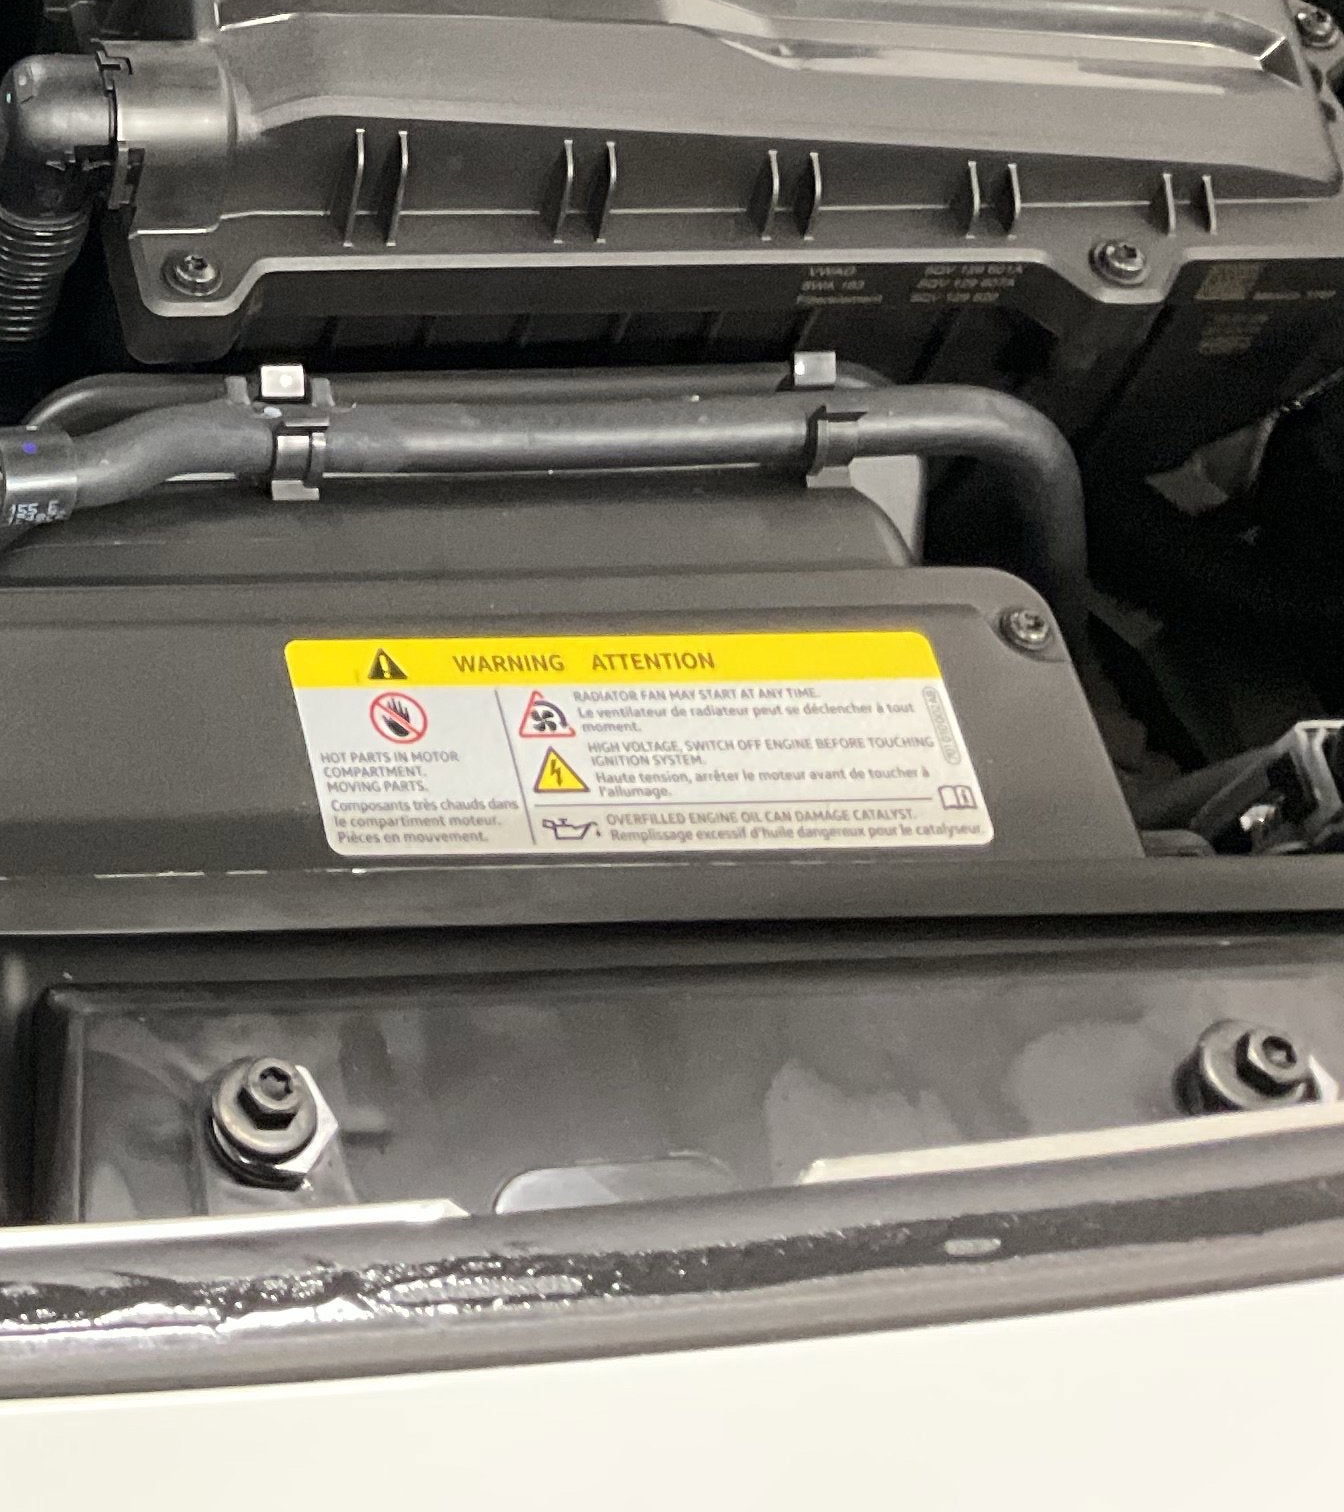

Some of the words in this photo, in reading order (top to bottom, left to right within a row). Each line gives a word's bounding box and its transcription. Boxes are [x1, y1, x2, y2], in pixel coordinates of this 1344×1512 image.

[452, 655, 565, 672] WARNING
[592, 652, 715, 671] ATTENTION
[573, 690, 638, 702] RADIATOR
[641, 690, 666, 700] FAN
[669, 690, 695, 701] MAY
[699, 689, 736, 700] START
[741, 688, 754, 699] AT
[759, 689, 782, 698] ANY
[577, 707, 594, 719] Le
[597, 706, 666, 718] ventilateur
[671, 706, 687, 717] de
[690, 705, 748, 716] radiateur
[752, 705, 782, 717] peut
[785, 706, 800, 715] se
[803, 702, 872, 715] déclencher
[876, 702, 884, 713] à
[886, 703, 914, 713] tout
[582, 722, 641, 732] moment.
[588, 742, 620, 753] HIGH
[685, 740, 734, 751] SWITCH
[737, 740, 761, 751] OFF
[765, 739, 812, 750] ENGINE
[815, 738, 865, 749] BEFORE
[868, 737, 934, 748] TOUCHING
[320, 752, 346, 763] HOT
[350, 752, 391, 763] PARTS
[394, 752, 408, 762] IN
[411, 751, 459, 762] MOTOR
[591, 755, 649, 766] IGNITION
[595, 772, 636, 783] Haute
[695, 769, 738, 782] arrêter
[742, 769, 755, 781] le
[759, 771, 805, 781] moteur
[810, 769, 846, 780] avant
[849, 768, 865, 779] de
[868, 767, 917, 779] toucher
[922, 766, 930, 778] à
[327, 781, 381, 792] MOVING
[331, 800, 411, 816] Composants
[413, 799, 438, 811] très
[440, 799, 486, 811] chauds
[488, 799, 519, 811] dans
[334, 816, 347, 827] le
[350, 816, 446, 830] compartiment
[449, 816, 501, 826] moteur.
[606, 813, 686, 825] OVERFILLED
[689, 812, 738, 824] ENGINE
[741, 811, 762, 823] OIL
[765, 811, 792, 822] CAN
[794, 810, 850, 822] DAMAGE
[383, 832, 400, 843] en
[610, 828, 693, 842] Remplissage
[696, 826, 746, 840] excessif
[750, 826, 794, 839] d'huile
[797, 826, 865, 839] dangereux
[868, 827, 897, 838] pour
[899, 824, 912, 836] le
